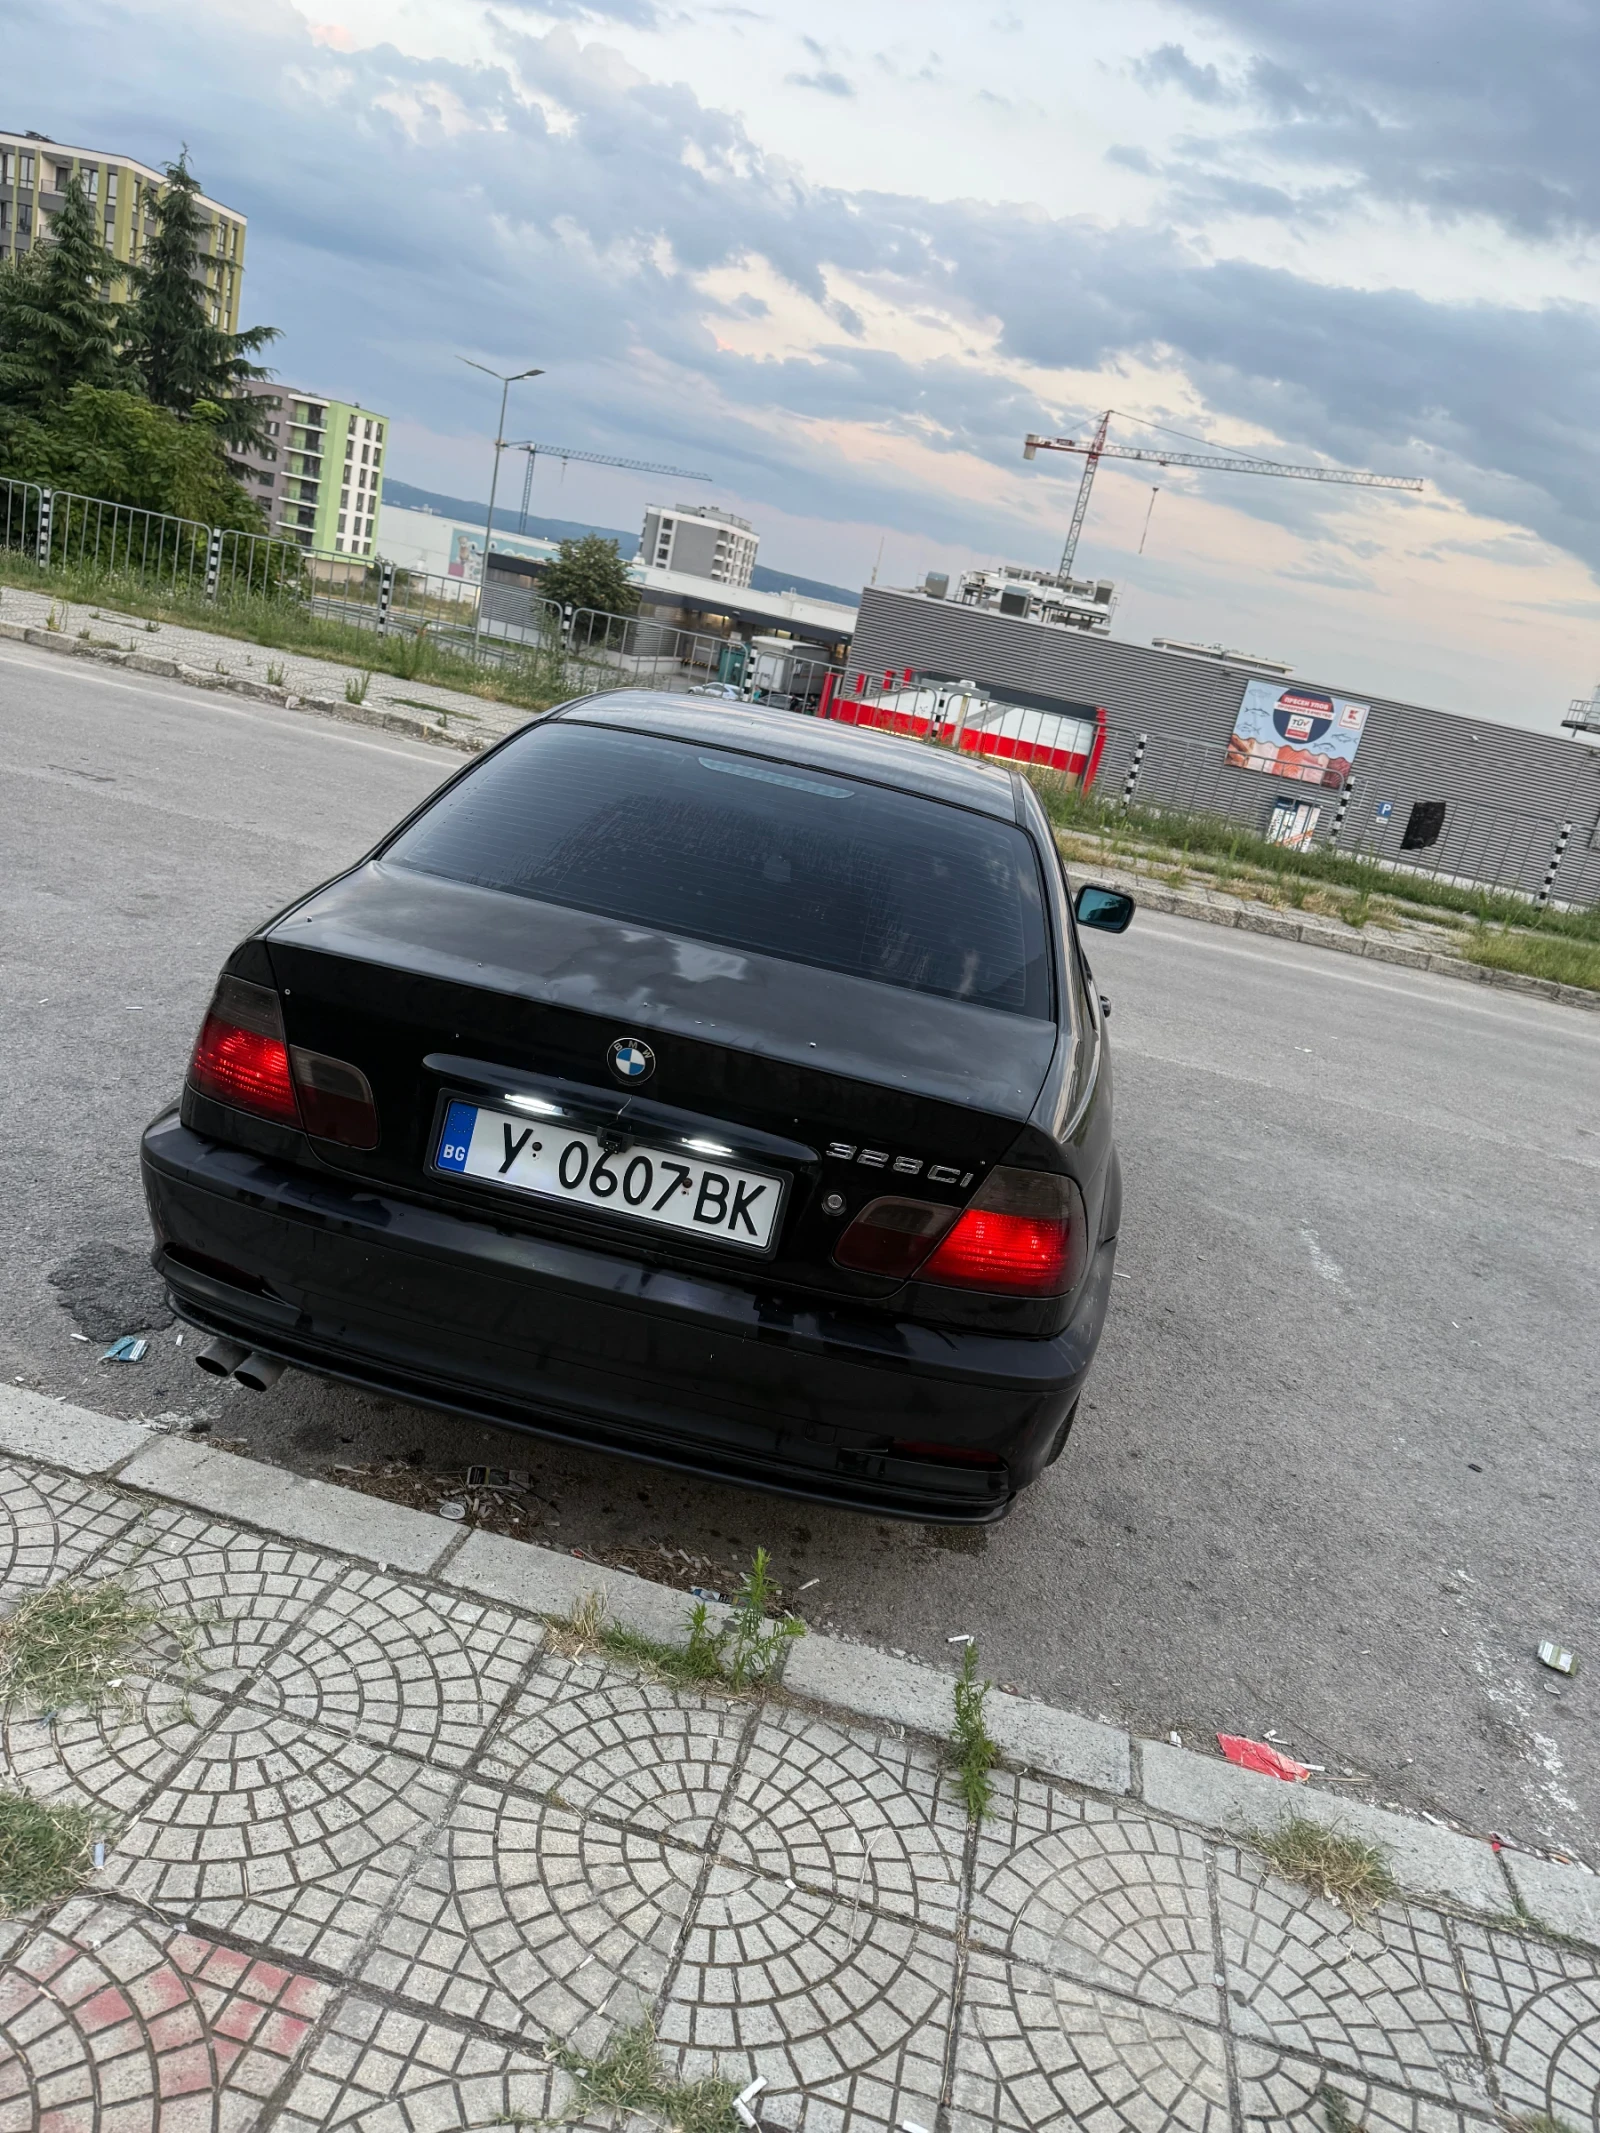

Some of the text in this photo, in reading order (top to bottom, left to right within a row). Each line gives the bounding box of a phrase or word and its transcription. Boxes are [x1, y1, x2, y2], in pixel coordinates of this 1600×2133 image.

[1382, 803, 1391, 815] P
[613, 1040, 653, 1059] BMW
[443, 1143, 466, 1162] BG
[558, 1140, 691, 1212] 0607
